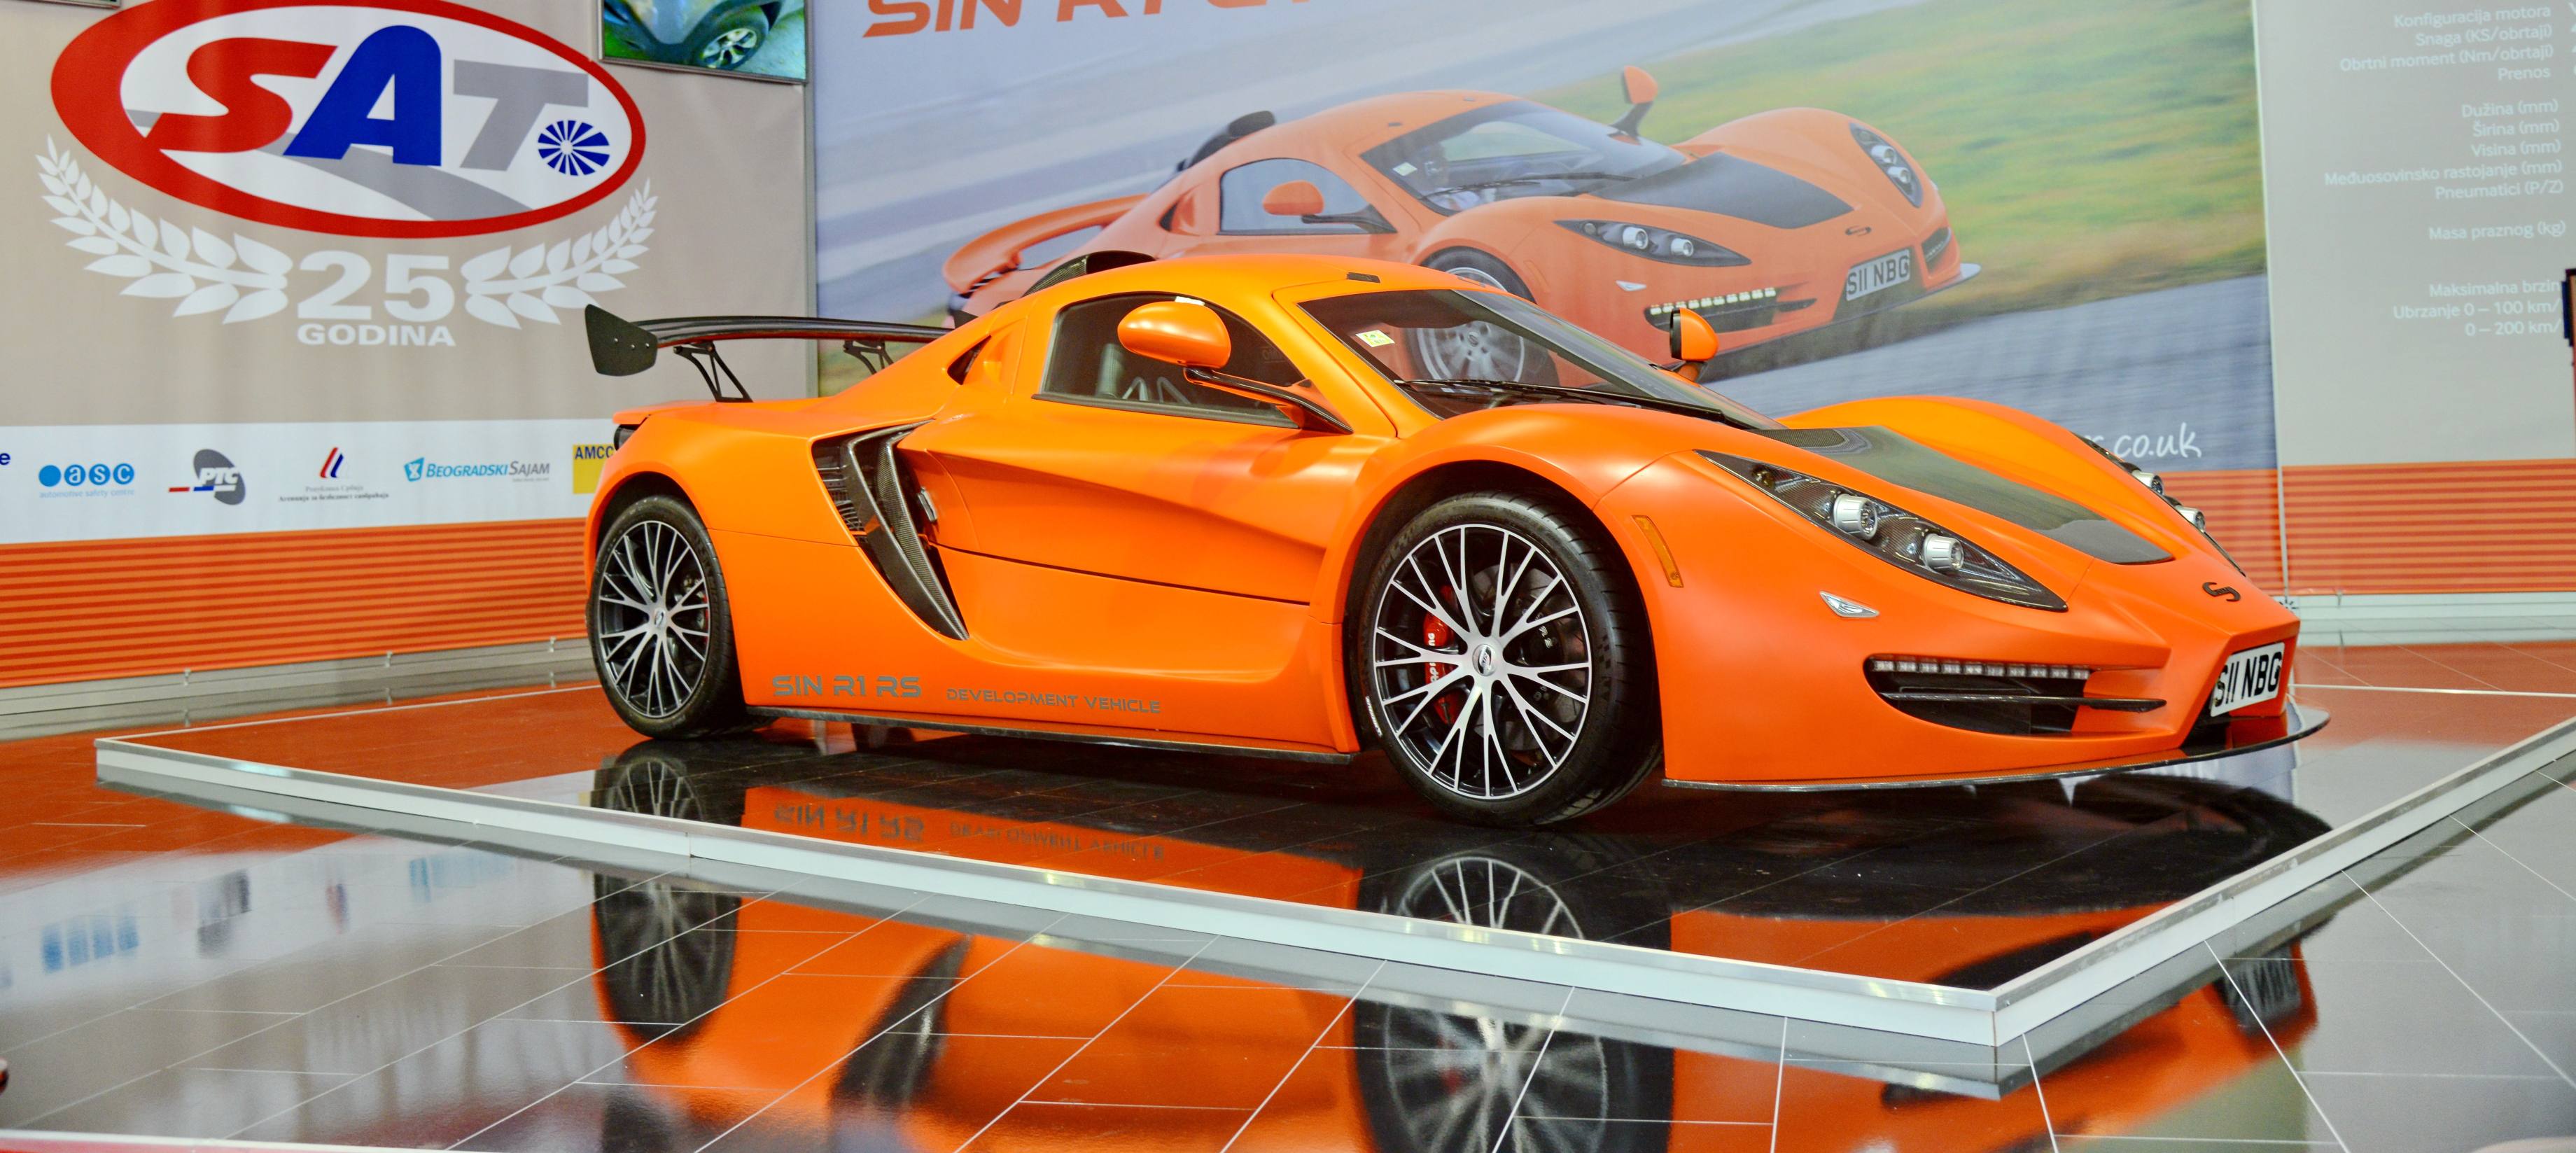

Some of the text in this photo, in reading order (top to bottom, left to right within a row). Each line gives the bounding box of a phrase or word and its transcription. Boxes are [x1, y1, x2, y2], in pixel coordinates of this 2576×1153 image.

[2394, 10, 2491, 29] Konfiguracija
[2496, 6, 2551, 20] motora
[2416, 31, 2462, 48] Snaga
[2465, 23, 2552, 43] (KS/obrtaji)
[2340, 55, 2386, 71] Obrtni
[2391, 53, 2456, 69] moment
[2459, 45, 2554, 64] (Nm/obrtaji)
[2498, 67, 2550, 81] Prenos
[139, 25, 589, 172] SAT
[2461, 99, 2558, 118] Dužina (mm)
[2473, 120, 2559, 137] Širina (mm)
[2471, 140, 2561, 157] Visina (mm)
[2325, 160, 2562, 186] Međuosovinsko rastojanje (mm)
[2435, 179, 2563, 200] Pneumatici (P/Z)
[2429, 220, 2566, 241] Masa praznog (kg)
[1873, 256, 1910, 287] NBG
[297, 250, 455, 323] 25
[2429, 279, 2562, 298] Maksimalna brzin
[2393, 304, 2460, 320] Ubrzanje
[2494, 300, 2523, 314] 100
[2527, 298, 2563, 314] km/
[297, 324, 456, 347] GODINA
[2495, 321, 2524, 335] 200
[2528, 318, 2563, 334] km/
[2085, 422, 2202, 458] co.uk
[772, 675, 922, 699] SIN R1 RS
[2241, 651, 2282, 700] NBG
[946, 688, 1161, 714] DEVELOPMENT VEHICLE
